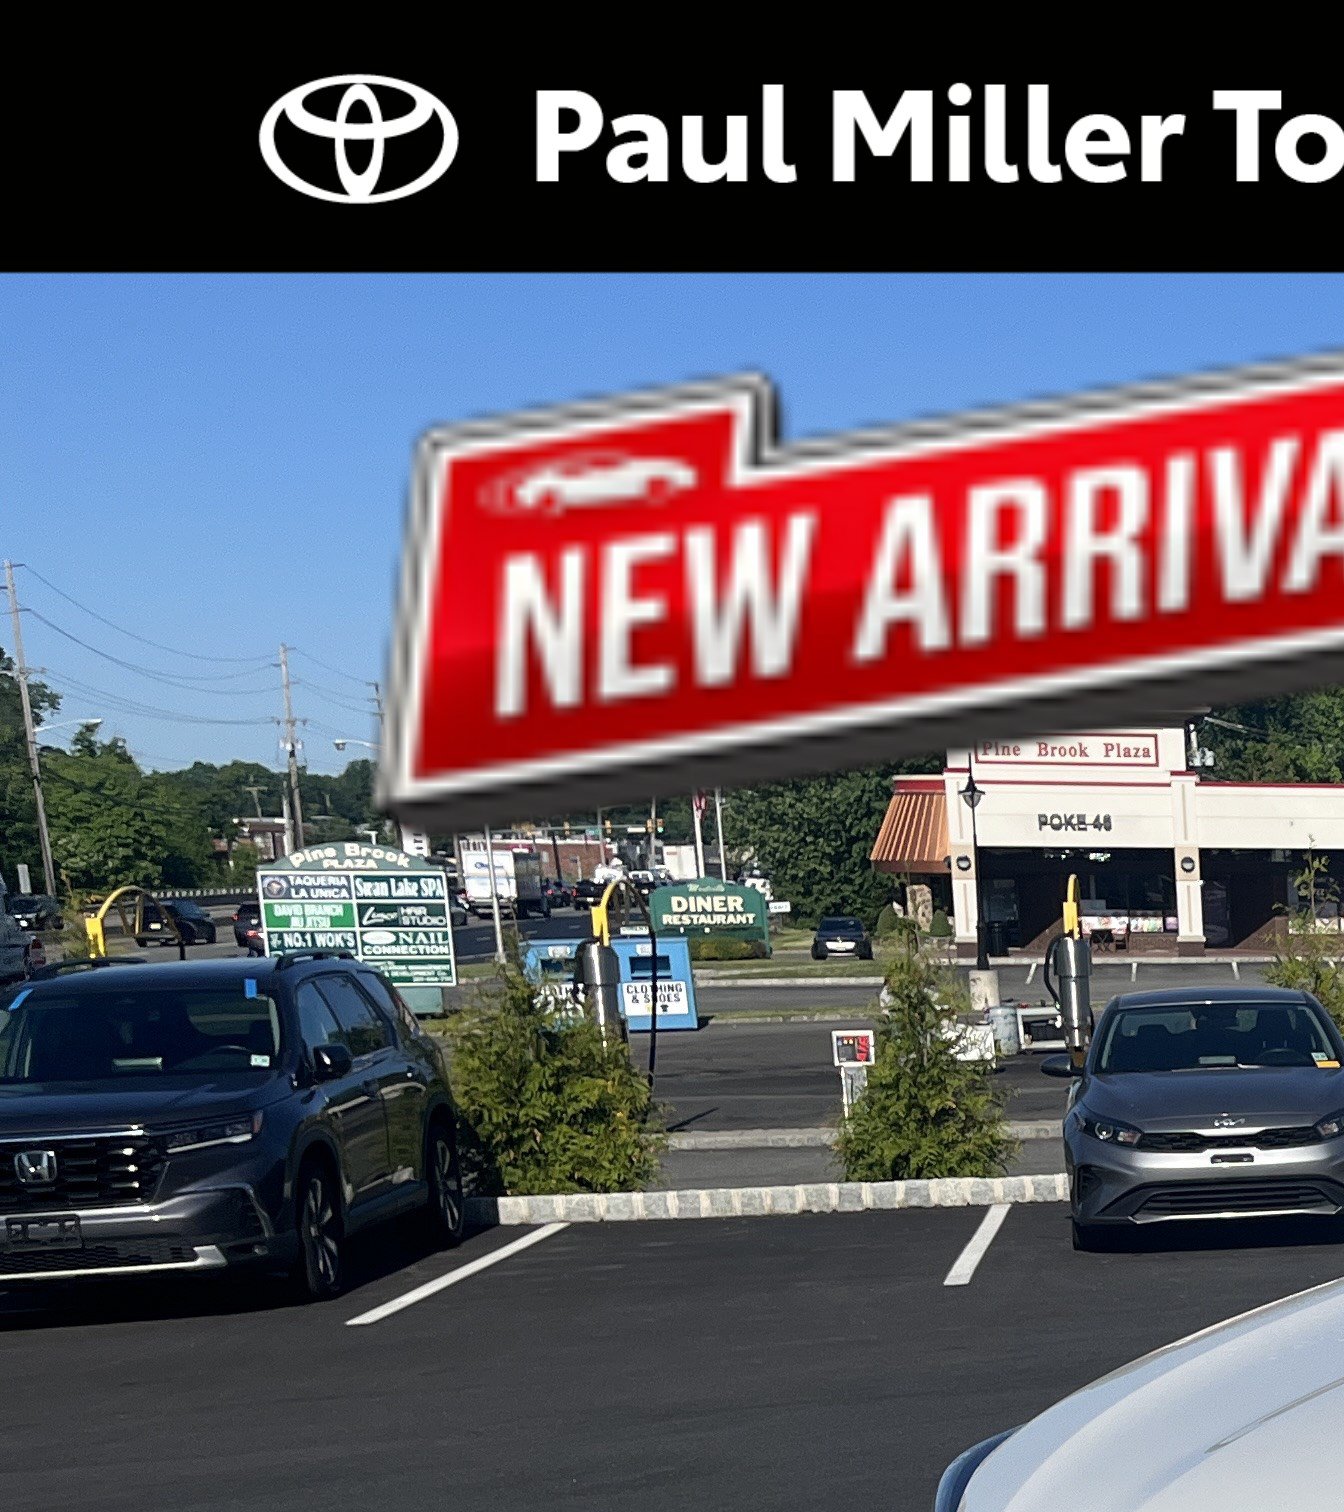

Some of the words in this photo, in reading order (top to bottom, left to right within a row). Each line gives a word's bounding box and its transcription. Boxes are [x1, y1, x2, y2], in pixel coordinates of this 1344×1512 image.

[981, 742, 1021, 756] Pine
[1036, 742, 1089, 757] Brook
[1103, 742, 1152, 758] Plaza
[1037, 813, 1088, 831] POKE
[289, 847, 337, 868] Pine
[344, 842, 411, 868] Brook
[322, 858, 379, 869] PLAZA
[287, 875, 348, 887] TAQUERIA
[419, 877, 445, 897] SPA
[290, 888, 309, 899] LA
[670, 895, 745, 913] DINER
[401, 915, 447, 926] STUDIO
[661, 913, 757, 925] RESTAURANT
[313, 932, 356, 948] WOK'S
[398, 932, 449, 944] NAIL
[362, 945, 450, 955] CONNECTION
[626, 983, 683, 994] CLOHING
[643, 993, 681, 1004] SOES
